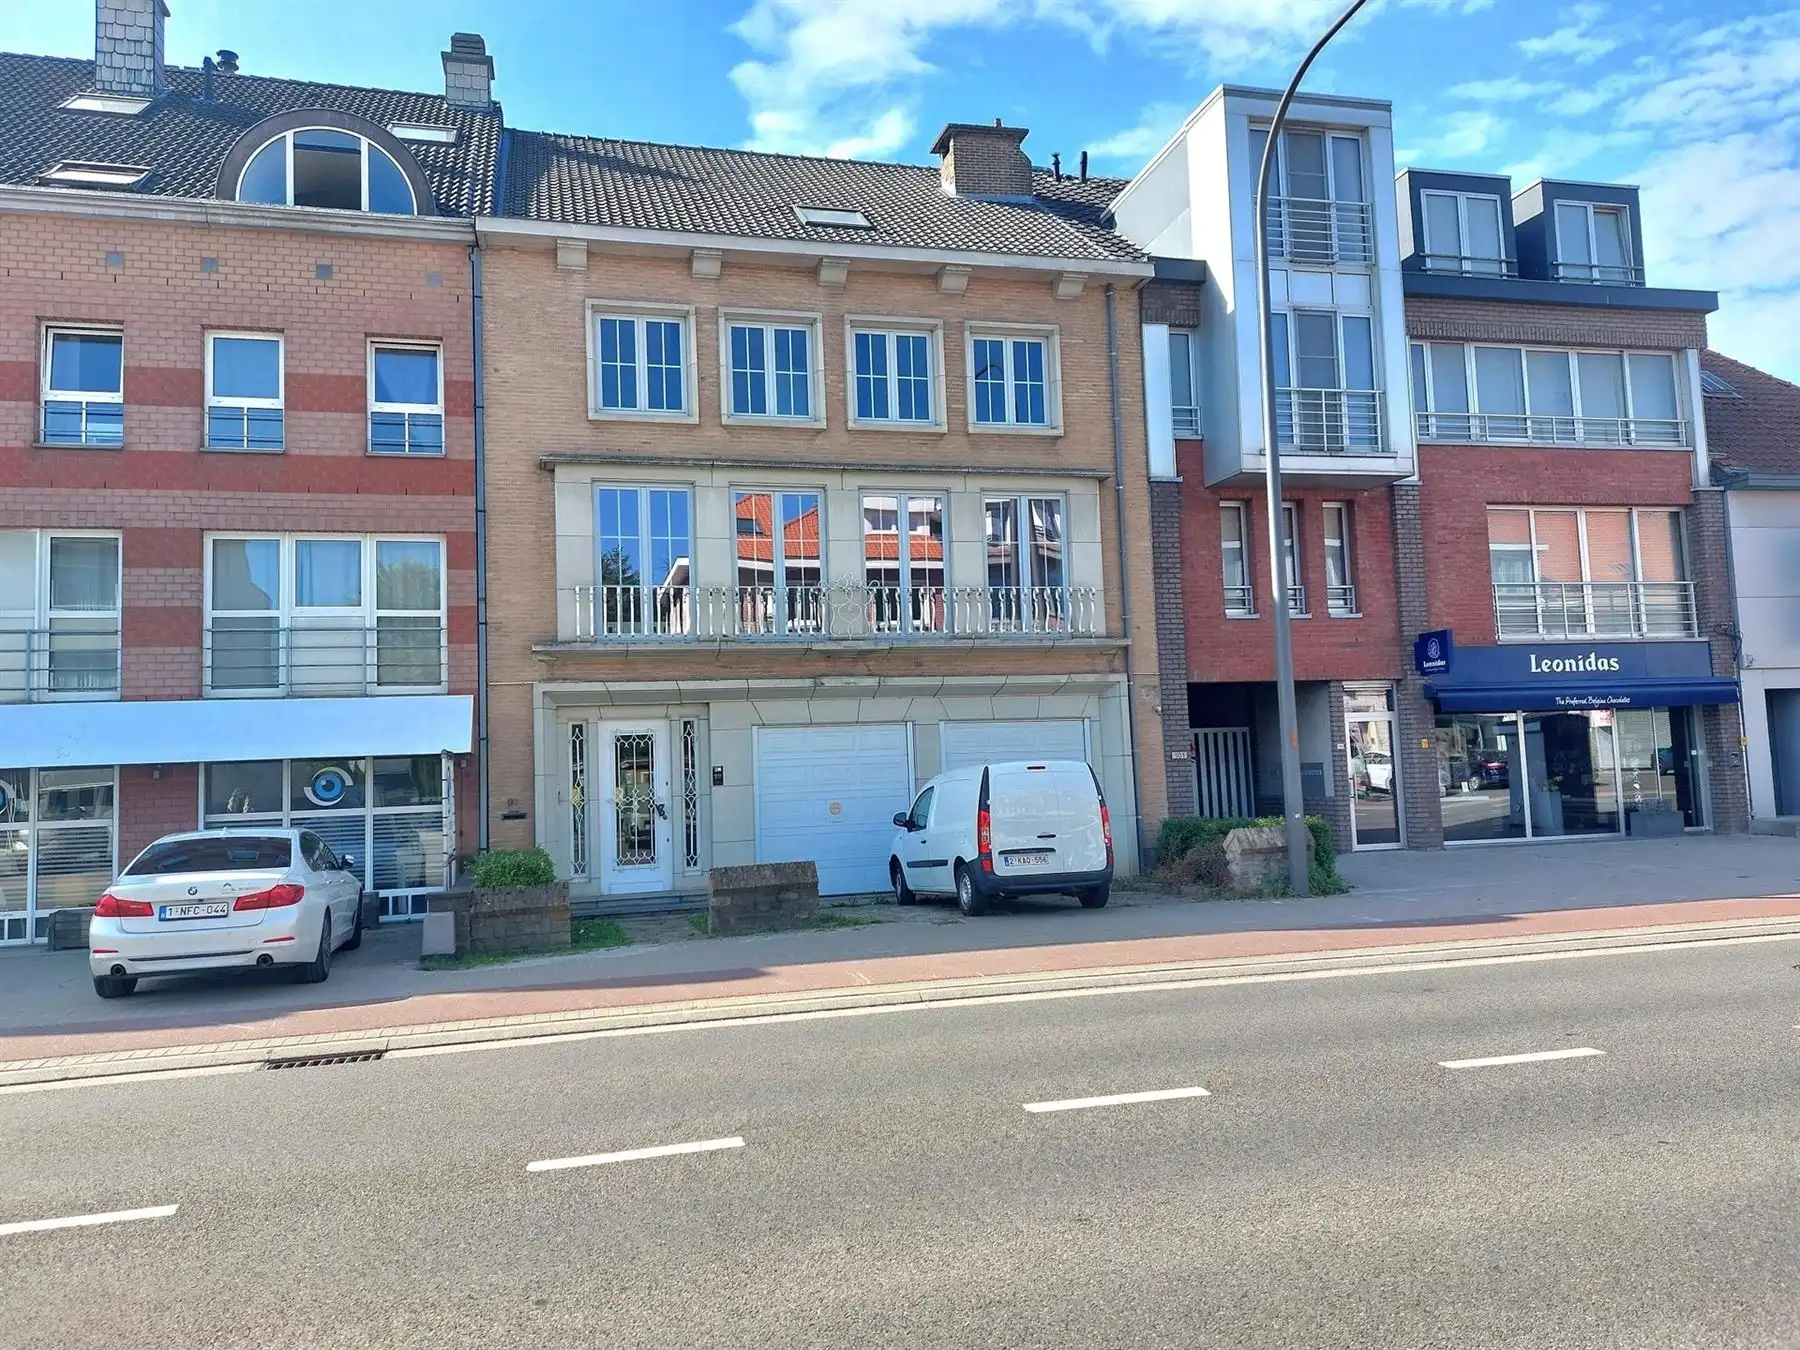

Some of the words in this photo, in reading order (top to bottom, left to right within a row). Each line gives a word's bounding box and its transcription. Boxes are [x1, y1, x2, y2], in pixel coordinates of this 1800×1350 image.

[1423, 660, 1446, 668] Leonidas
[1529, 651, 1620, 673] Leonidas
[1555, 696, 1564, 705] The
[1588, 695, 1606, 708] Belgian
[168, 904, 226, 917] 1-NFC-044
